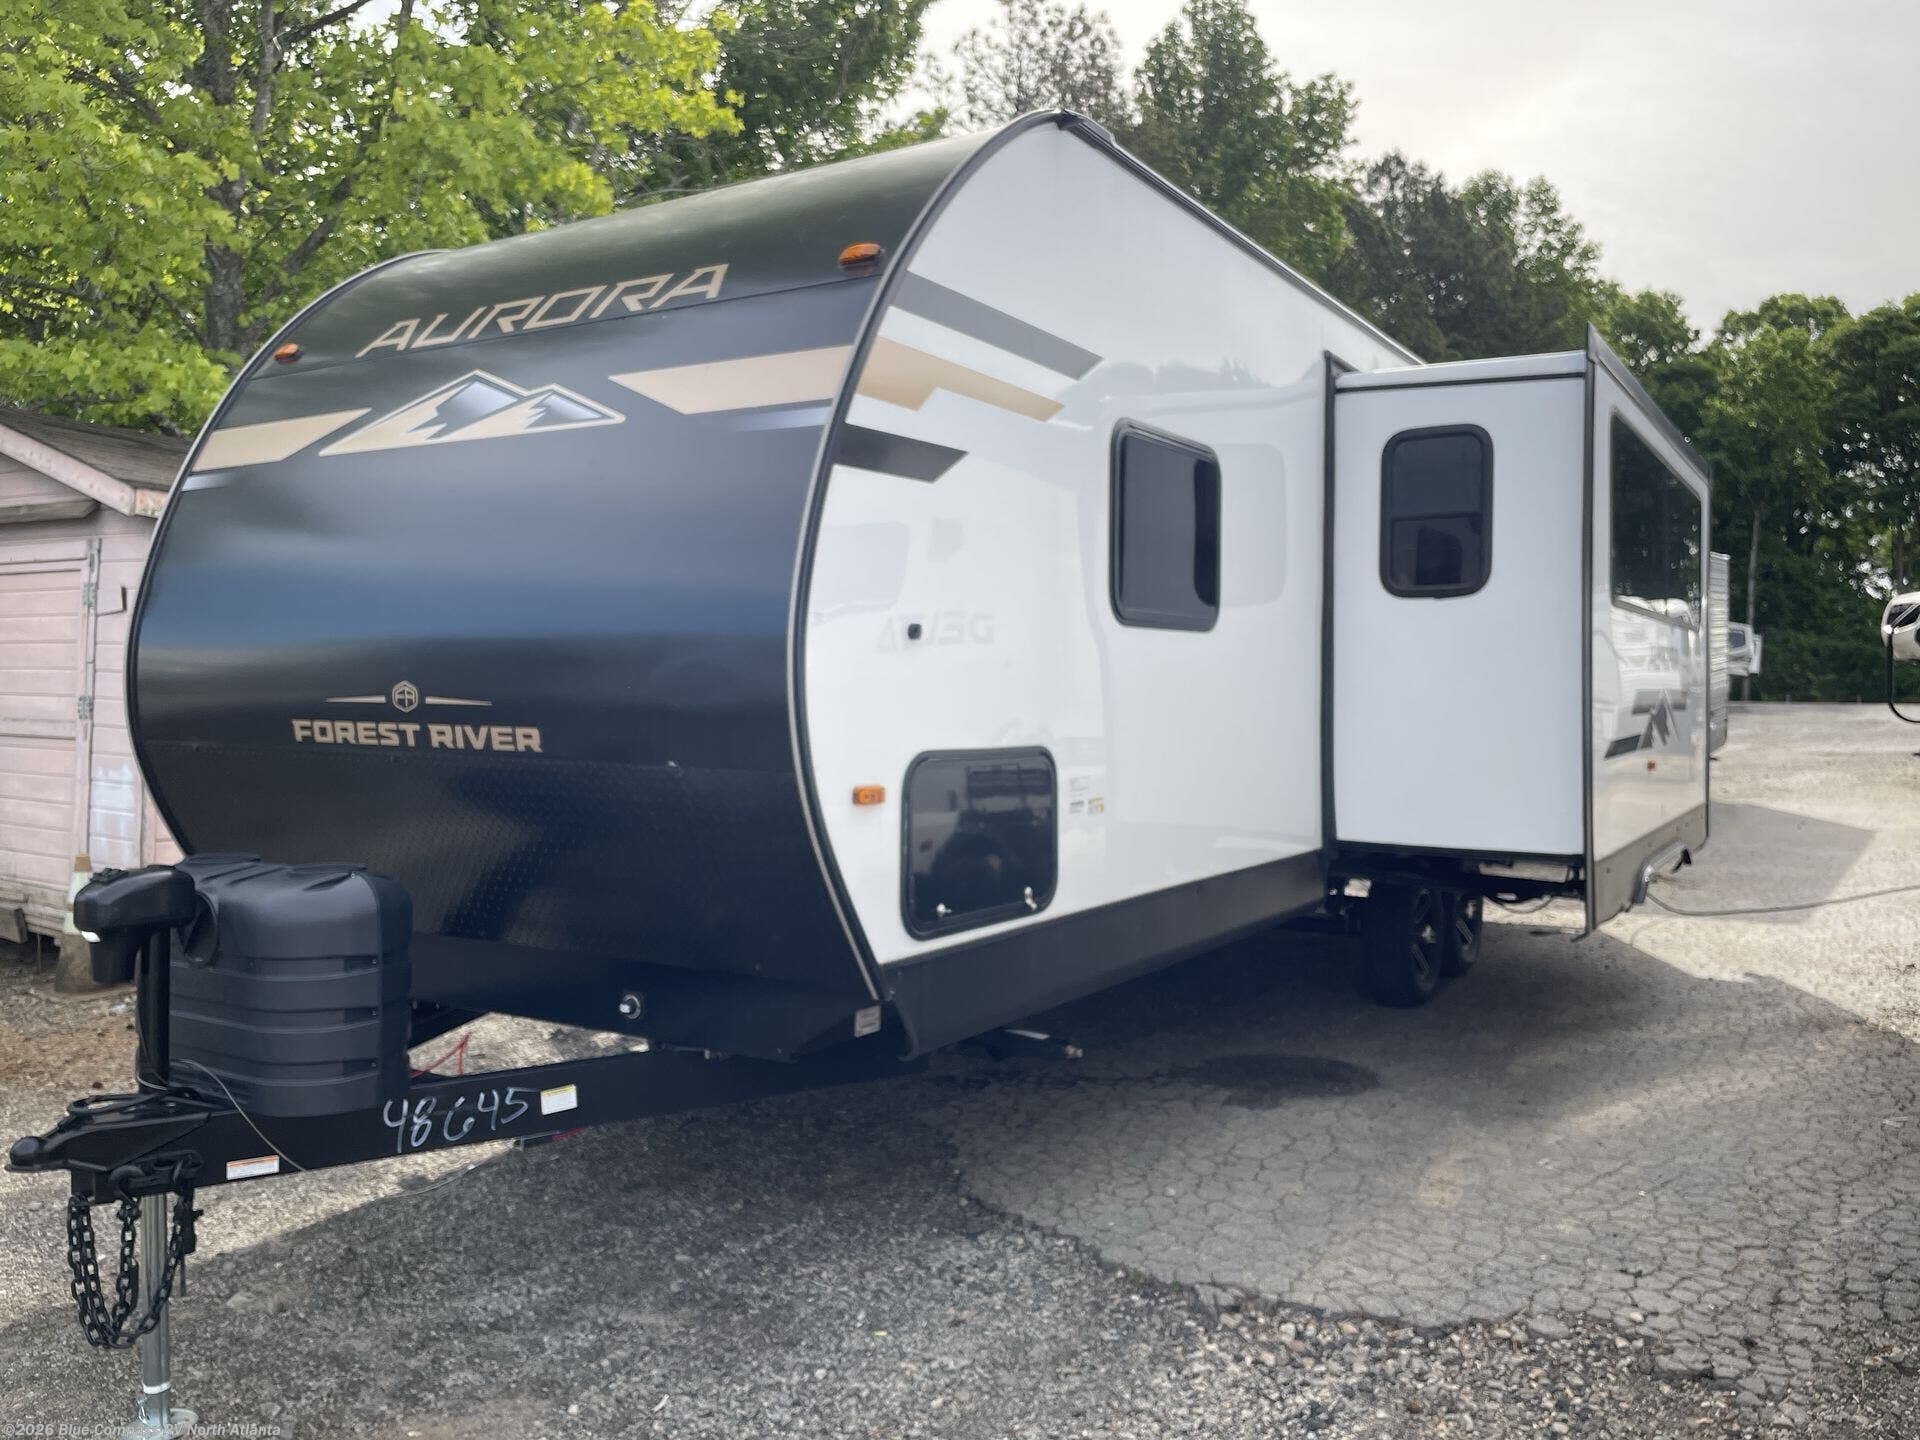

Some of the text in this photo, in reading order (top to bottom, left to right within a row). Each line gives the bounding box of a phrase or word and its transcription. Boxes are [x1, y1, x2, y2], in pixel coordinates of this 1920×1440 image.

[355, 263, 729, 359] AURORA
[291, 718, 544, 753] FOREST RIVER
[383, 1087, 542, 1154] 48645
